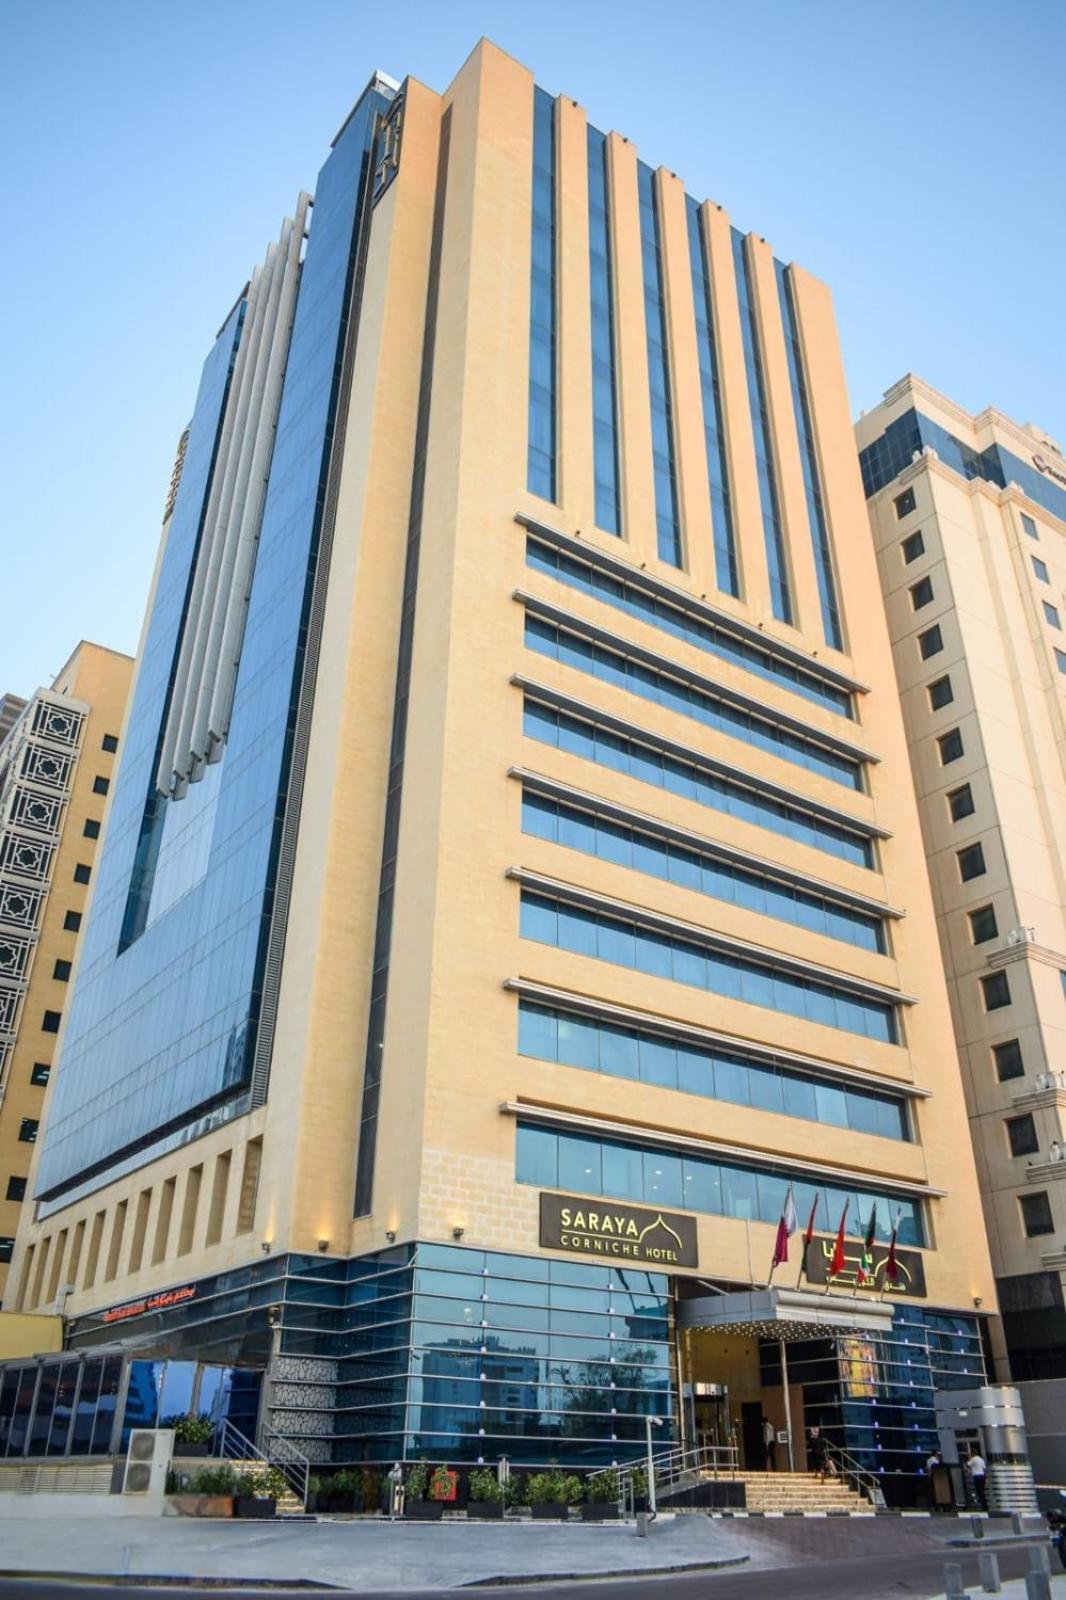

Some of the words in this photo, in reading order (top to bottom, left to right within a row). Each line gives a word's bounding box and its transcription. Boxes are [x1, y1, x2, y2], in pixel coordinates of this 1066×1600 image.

[561, 1208, 639, 1237] SARAYA
[560, 1235, 639, 1256] CORNICHE
[646, 1247, 678, 1262] HOTEL
